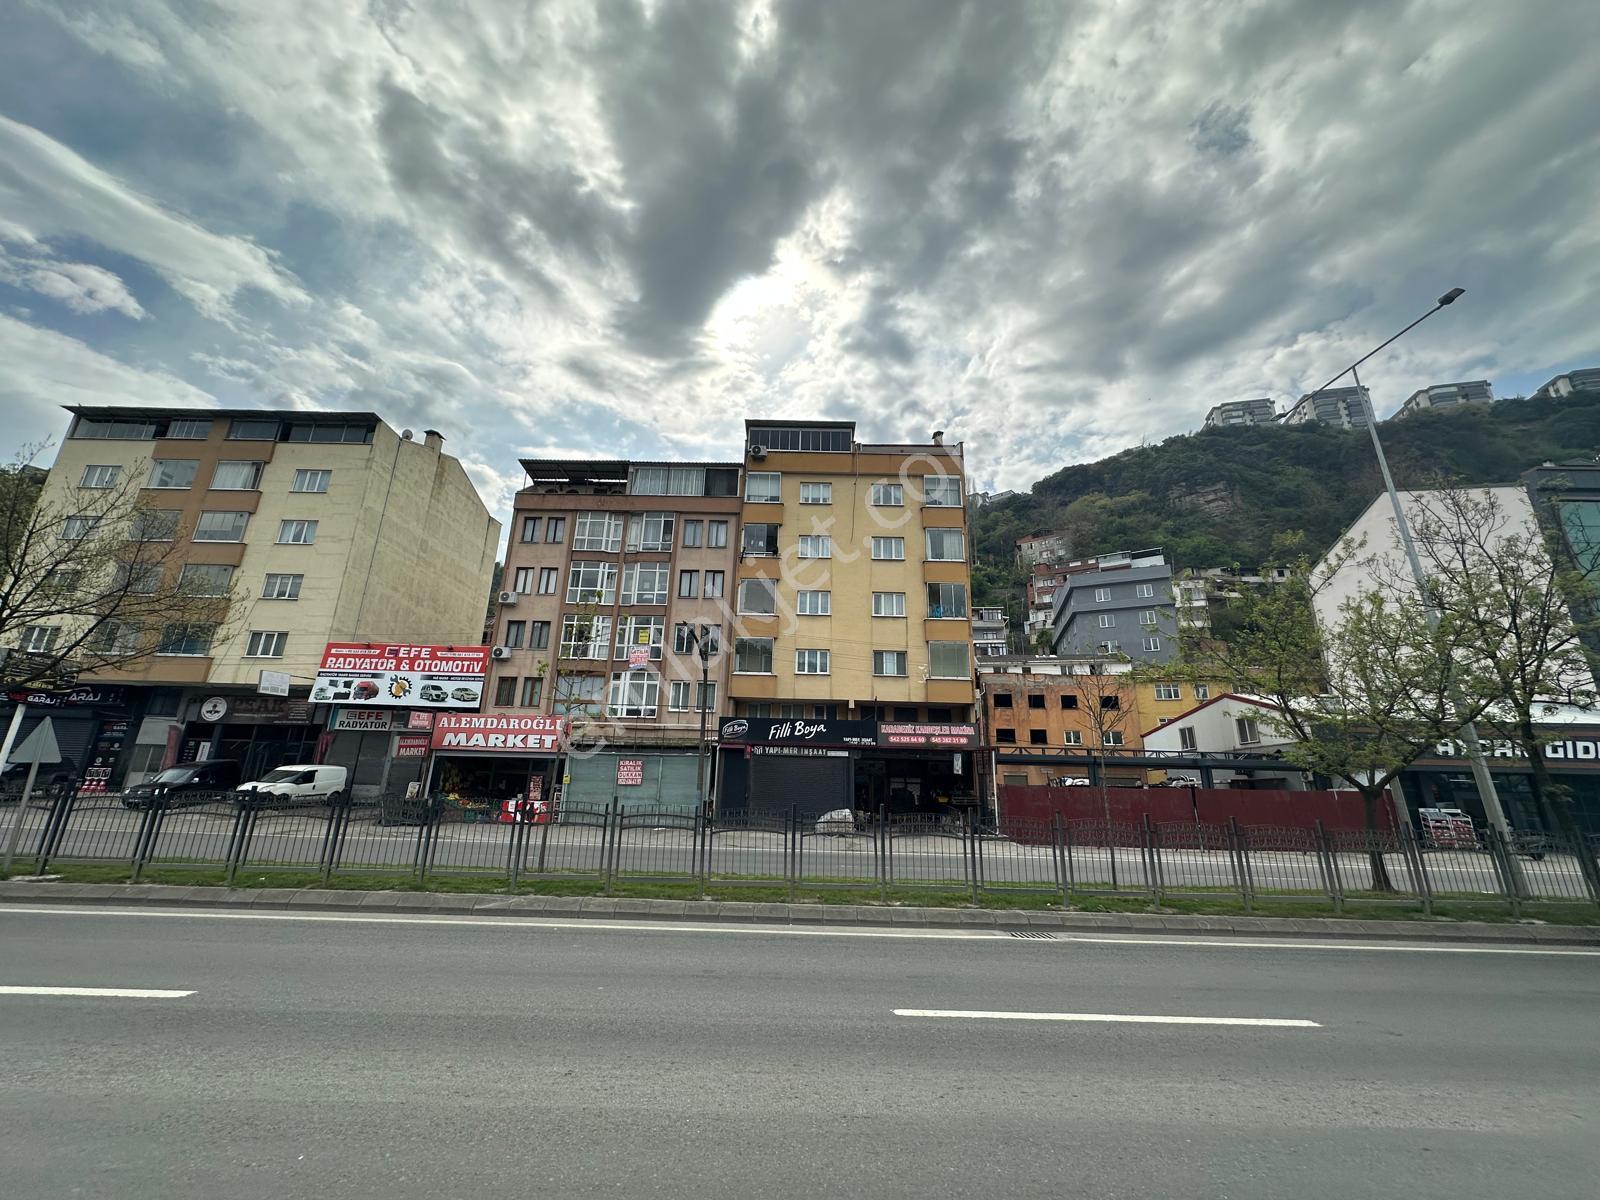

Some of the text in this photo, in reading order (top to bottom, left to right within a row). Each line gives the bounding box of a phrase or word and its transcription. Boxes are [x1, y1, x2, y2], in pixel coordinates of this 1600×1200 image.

[400, 659, 410, 671] &
[28, 695, 56, 704] GARAJ
[769, 720, 827, 740] Filli Boya
[442, 732, 557, 749] MARKET
[399, 747, 426, 756] MARKET
[1545, 740, 1600, 759] GID
